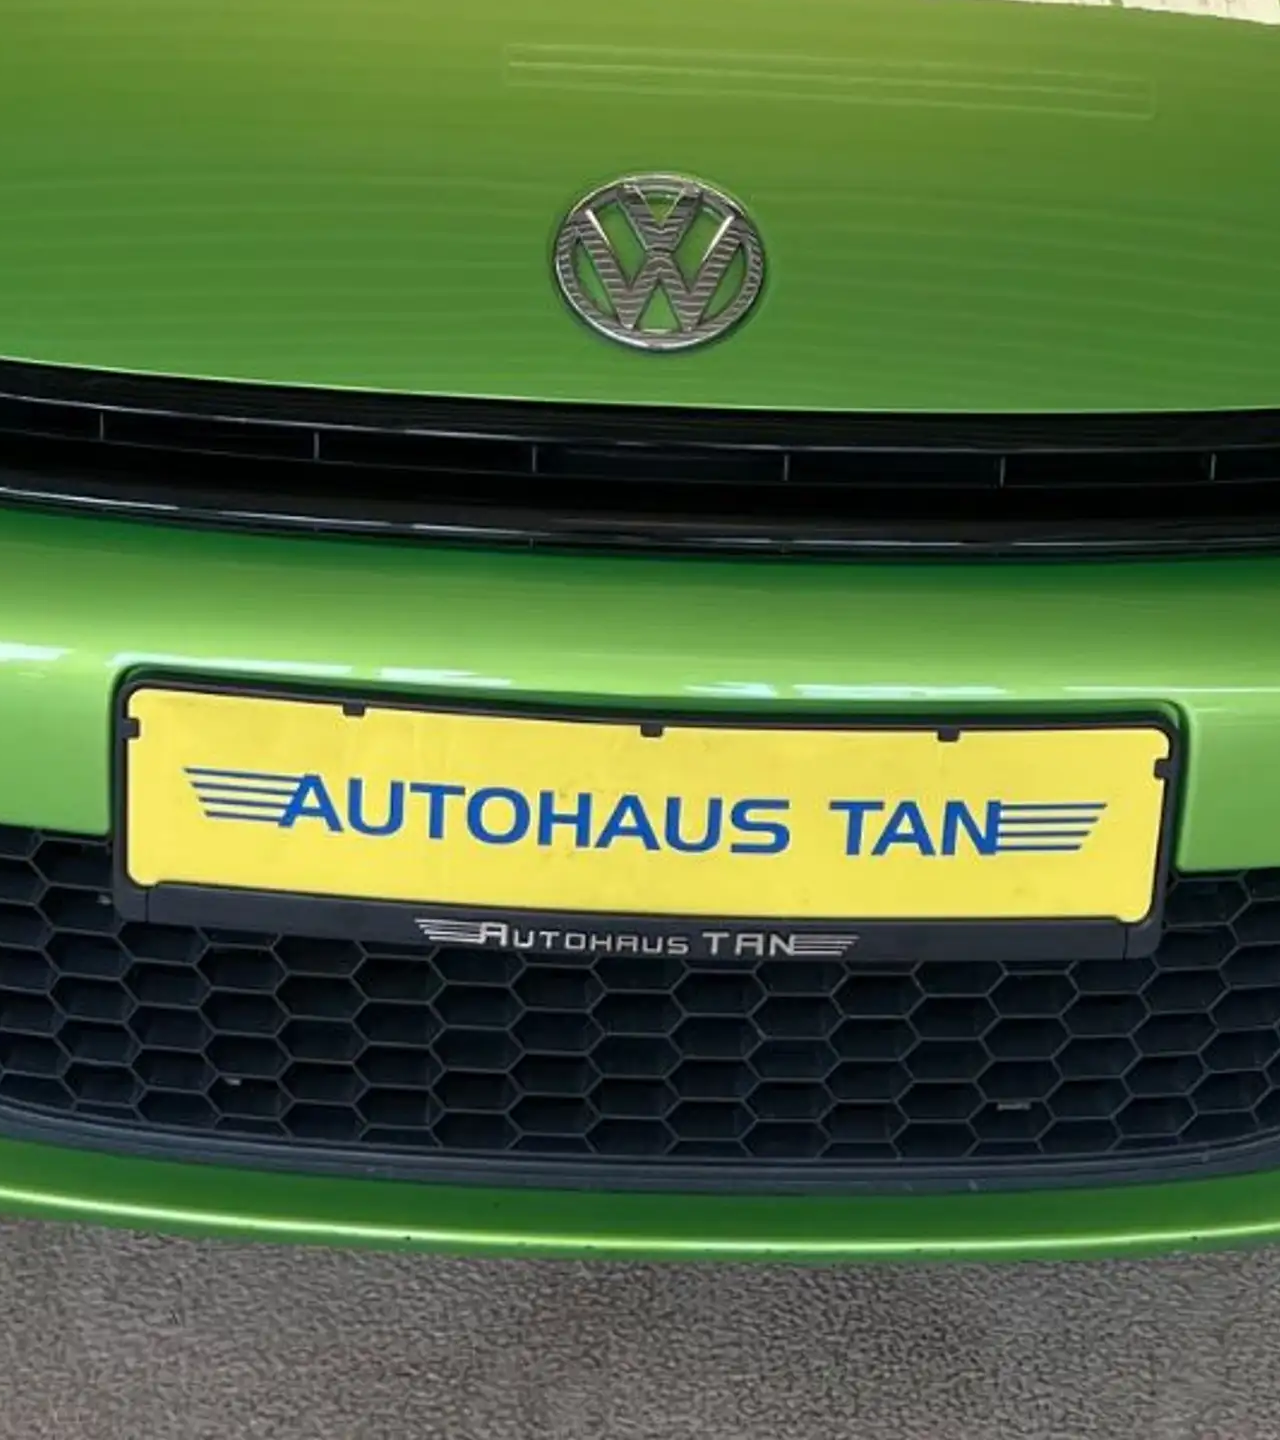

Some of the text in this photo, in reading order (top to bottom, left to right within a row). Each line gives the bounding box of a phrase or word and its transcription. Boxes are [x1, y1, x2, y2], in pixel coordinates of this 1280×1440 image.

[277, 773, 1003, 856] AUTOHAUS TAN
[478, 921, 795, 956] AUTOHAUS TAN
